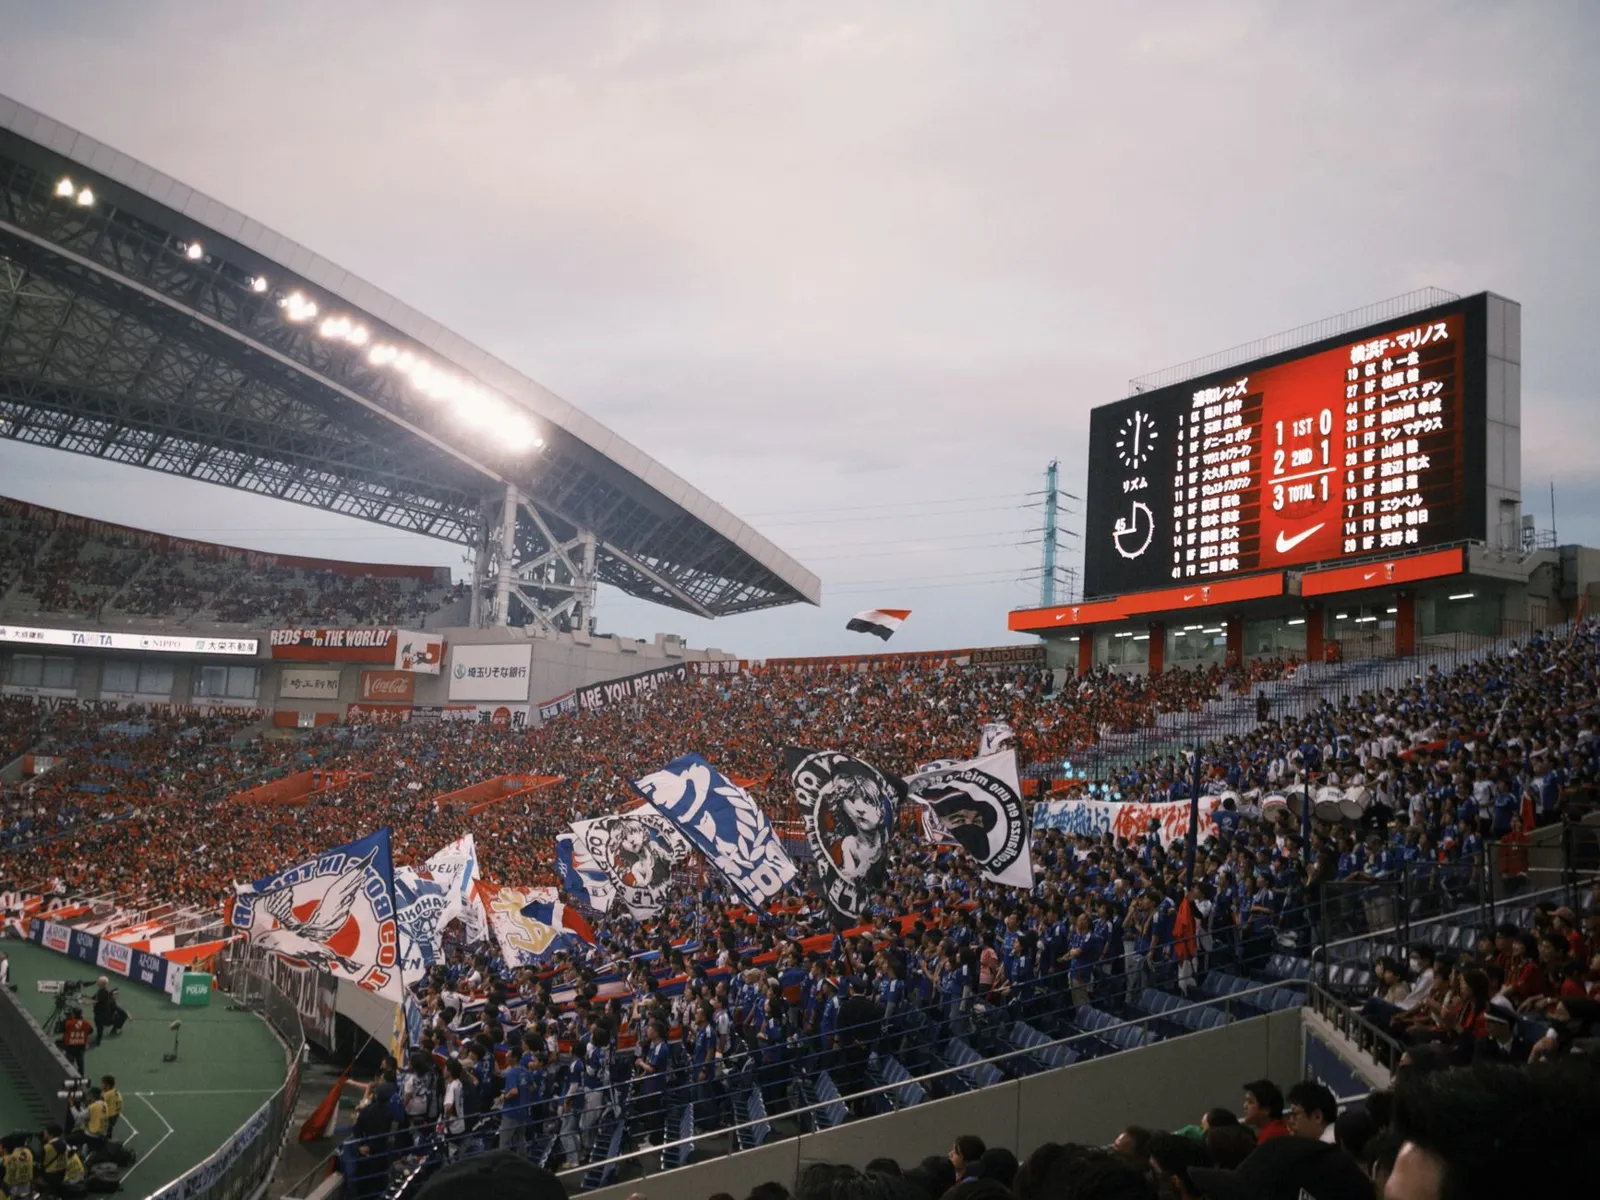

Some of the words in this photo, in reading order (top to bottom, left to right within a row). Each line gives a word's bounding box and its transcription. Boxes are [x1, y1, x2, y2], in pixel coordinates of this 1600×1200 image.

[1347, 367, 1359, 381] 19
[1192, 377, 1248, 408] 浦和レッズ
[1346, 384, 1358, 399] 27
[1346, 401, 1358, 415] 44
[1381, 386, 1419, 408] トーマス
[1421, 380, 1444, 398] デン
[1179, 415, 1183, 426] 1
[1275, 420, 1283, 445] 1
[1292, 417, 1313, 437] 1ST
[1320, 408, 1332, 435] 0
[1346, 418, 1358, 432] 33
[1178, 430, 1183, 440] 4
[1346, 435, 1357, 449] 11
[1381, 427, 1401, 441] ヤン
[1402, 416, 1443, 436] マテウス
[1177, 445, 1183, 456] 3
[1274, 449, 1285, 475] 2
[1291, 447, 1313, 467] 2ND
[1321, 439, 1329, 465] 1
[1177, 460, 1182, 471] 5
[1174, 475, 1183, 487] 21
[1347, 469, 1355, 483] 6
[1122, 476, 1148, 493] リズム
[1175, 490, 1183, 502] 11
[1273, 484, 1284, 510] 3
[1288, 483, 1315, 503] TOTAL
[1320, 475, 1328, 501] 1
[1346, 486, 1357, 500] 16
[1347, 505, 1355, 518] 7
[1380, 493, 1424, 512] エウベル
[1114, 518, 1127, 532] 45
[1345, 521, 1357, 535] 14
[1173, 535, 1182, 547] 14
[1344, 539, 1357, 553] 20
[1171, 567, 1181, 578] 41
[270, 630, 300, 645] REDS
[312, 638, 323, 647] TO
[324, 630, 343, 647] THE
[346, 630, 391, 647] WORLD!
[468, 667, 527, 678] 埼玉りそな銀行
[579, 691, 603, 709] ARE
[604, 680, 631, 701] YOU
[513, 711, 526, 726] 和
